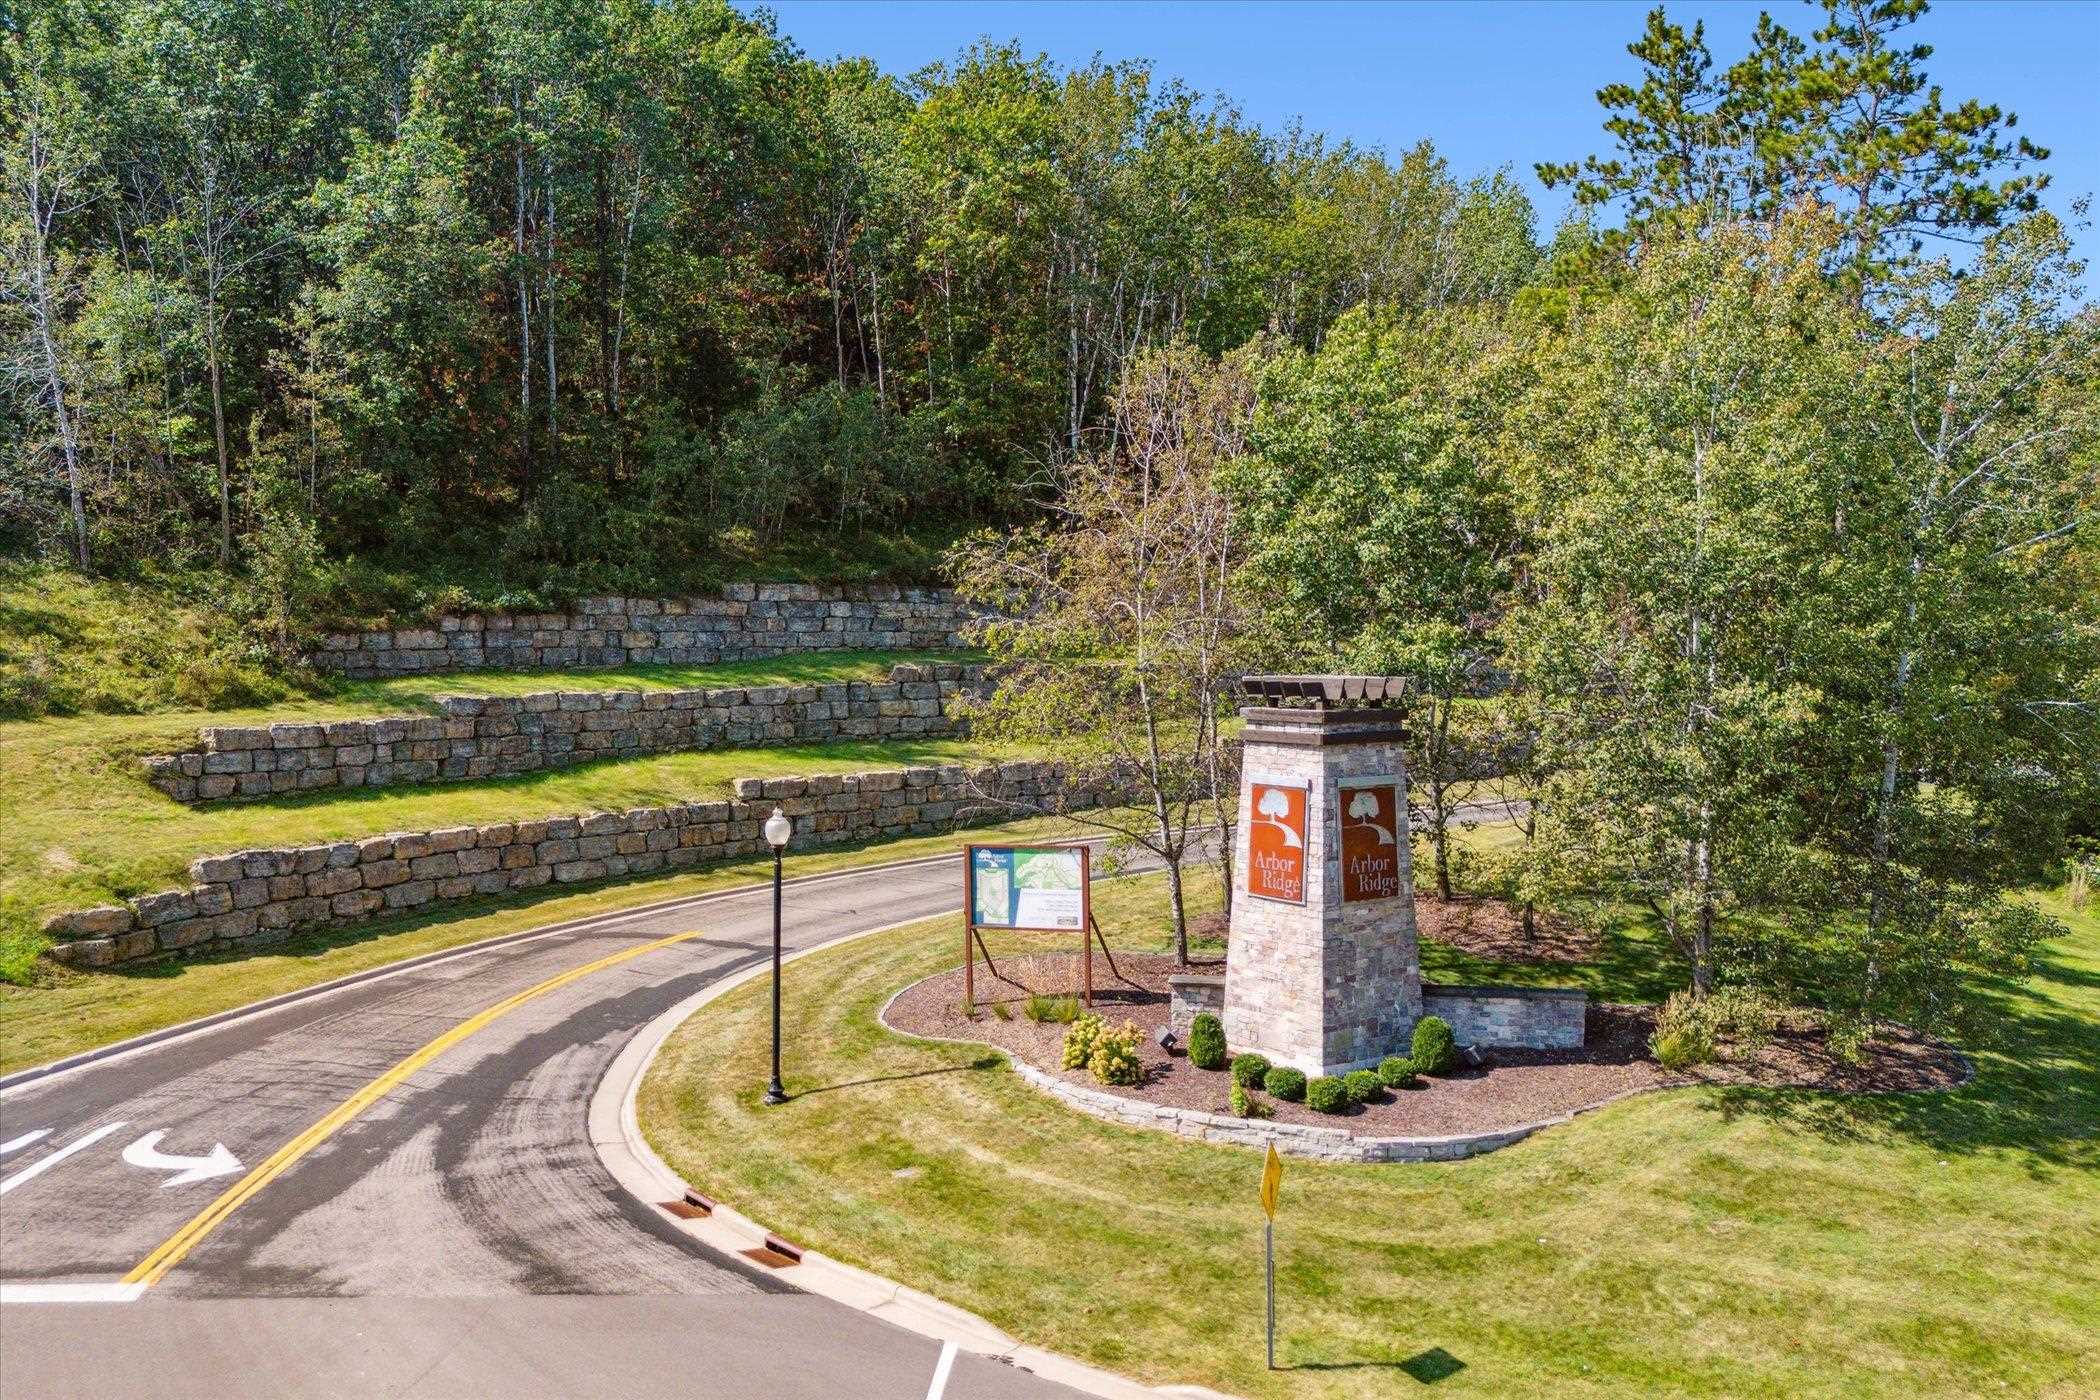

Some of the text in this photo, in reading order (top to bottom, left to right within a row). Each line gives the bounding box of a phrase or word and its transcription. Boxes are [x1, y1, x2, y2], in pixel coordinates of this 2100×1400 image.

[1255, 851, 1295, 872] Arbor
[1350, 854, 1390, 874] Arbor
[1262, 870, 1301, 898] Ridge
[1359, 873, 1397, 896] Ridge
